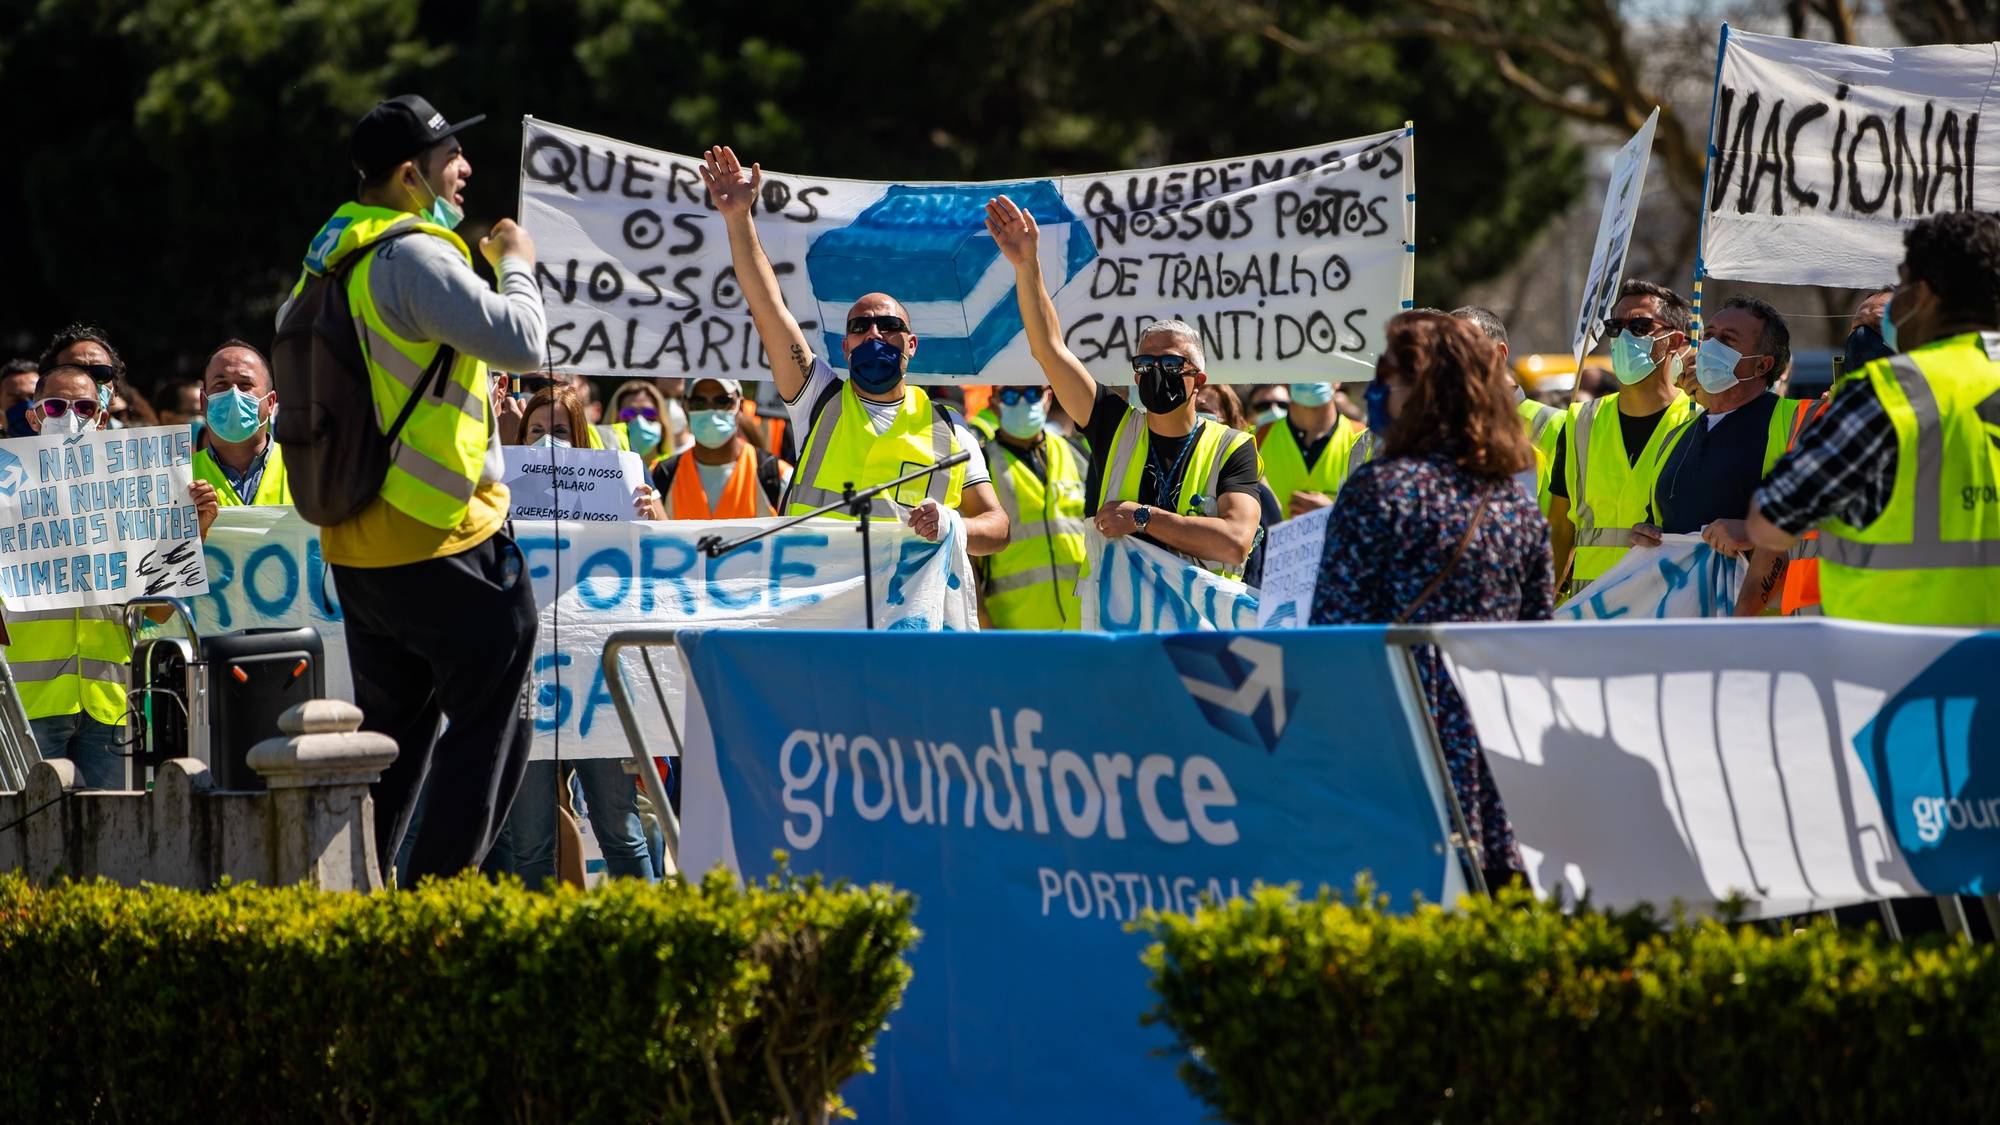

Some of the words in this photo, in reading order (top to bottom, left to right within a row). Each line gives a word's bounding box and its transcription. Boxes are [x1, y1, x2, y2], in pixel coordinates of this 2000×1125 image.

[525, 134, 829, 224] QUEROS
[1084, 148, 1347, 219] QUEREMOS
[1359, 137, 1404, 179] OS
[622, 209, 708, 256] OS
[1095, 194, 1258, 249] NOSSOS
[1276, 187, 1389, 239] POSTOS
[535, 259, 795, 314] NOSSO
[1090, 256, 1143, 299] DE
[546, 307, 818, 371] SALÁRI
[39, 434, 95, 483] NÃO
[105, 431, 192, 474] SOMOS
[521, 463, 575, 476] QUEREMOS
[577, 467, 586, 476] O
[588, 468, 624, 479] NOSSO
[19, 484, 60, 520] UM
[551, 479, 595, 492] SALARIO
[515, 506, 570, 519] QUEREMOS
[572, 511, 581, 520] O
[583, 512, 618, 521] NOSSO
[779, 707, 1240, 850] groundforce
